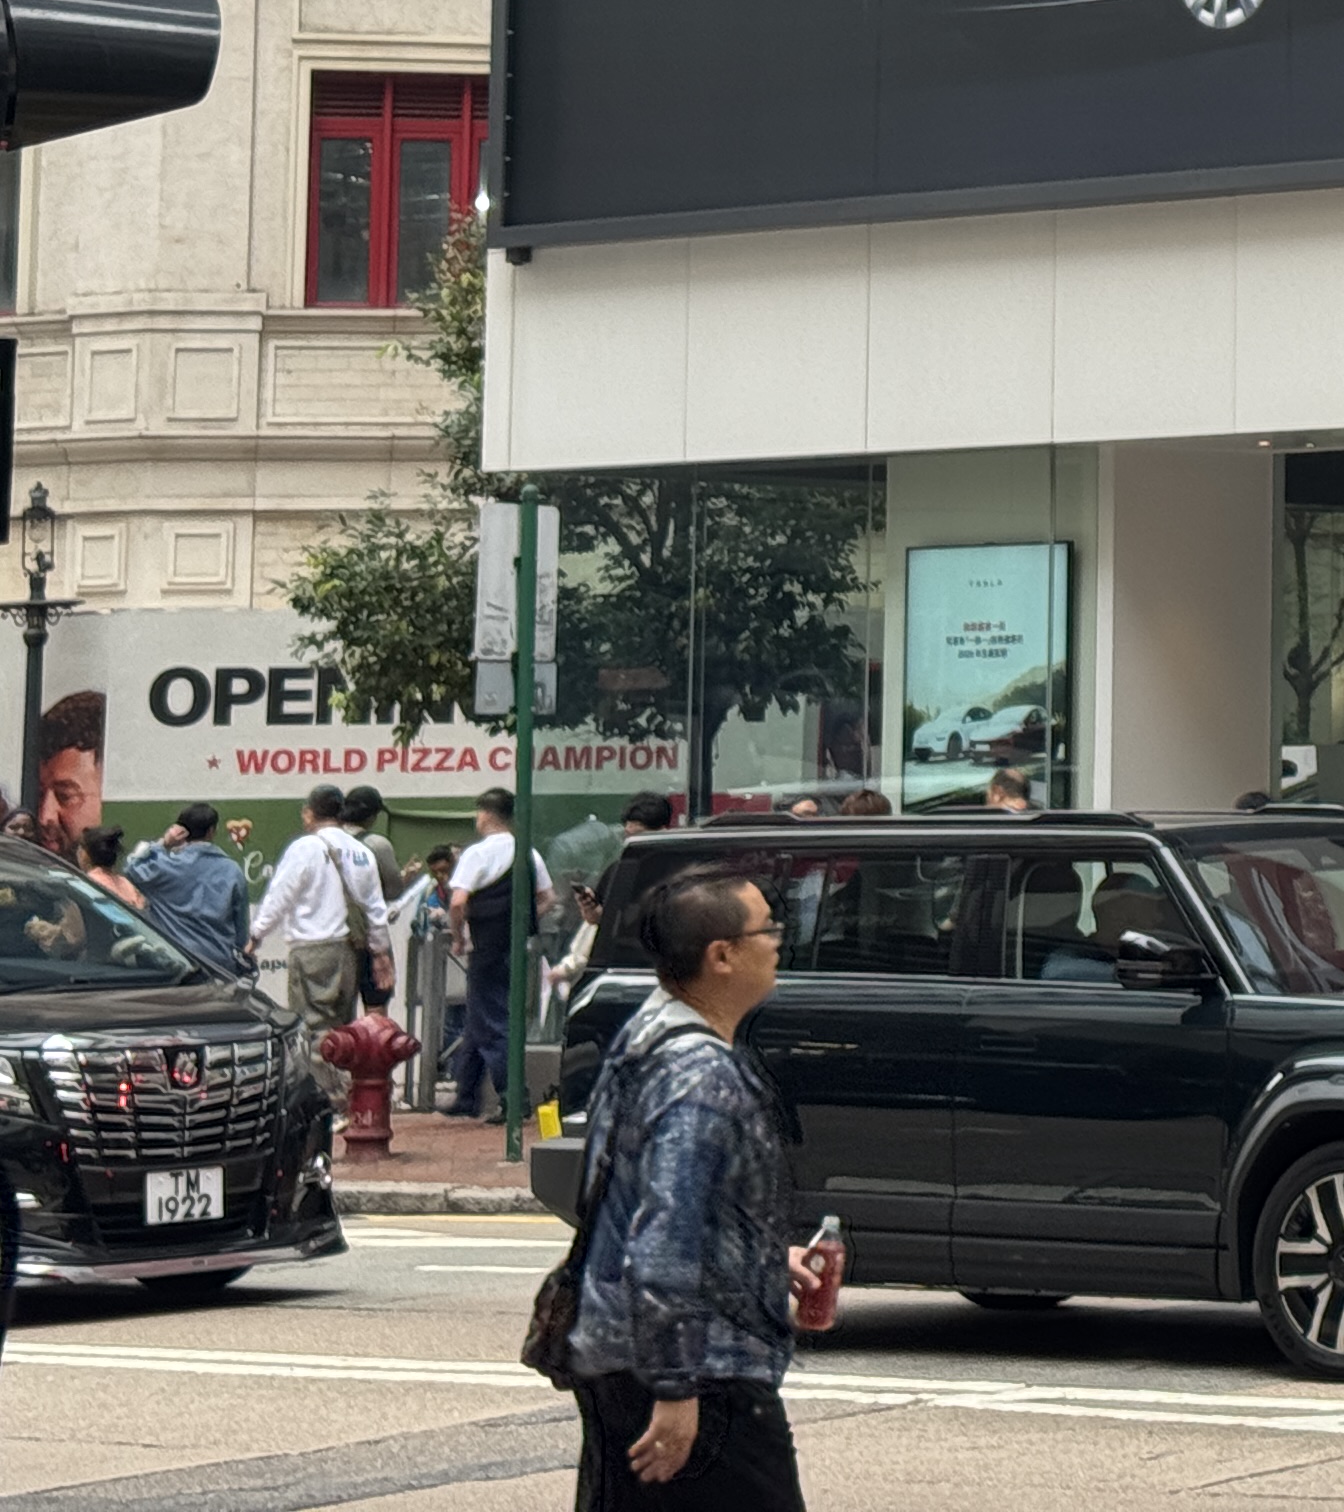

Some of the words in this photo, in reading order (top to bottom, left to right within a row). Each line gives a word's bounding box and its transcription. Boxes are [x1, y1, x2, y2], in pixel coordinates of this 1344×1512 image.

[236, 747, 368, 775] WORLD
[376, 745, 481, 774] PIZZA
[488, 743, 680, 773] CAMPION
[169, 1169, 200, 1196] TM
[158, 1193, 212, 1221] 1922
